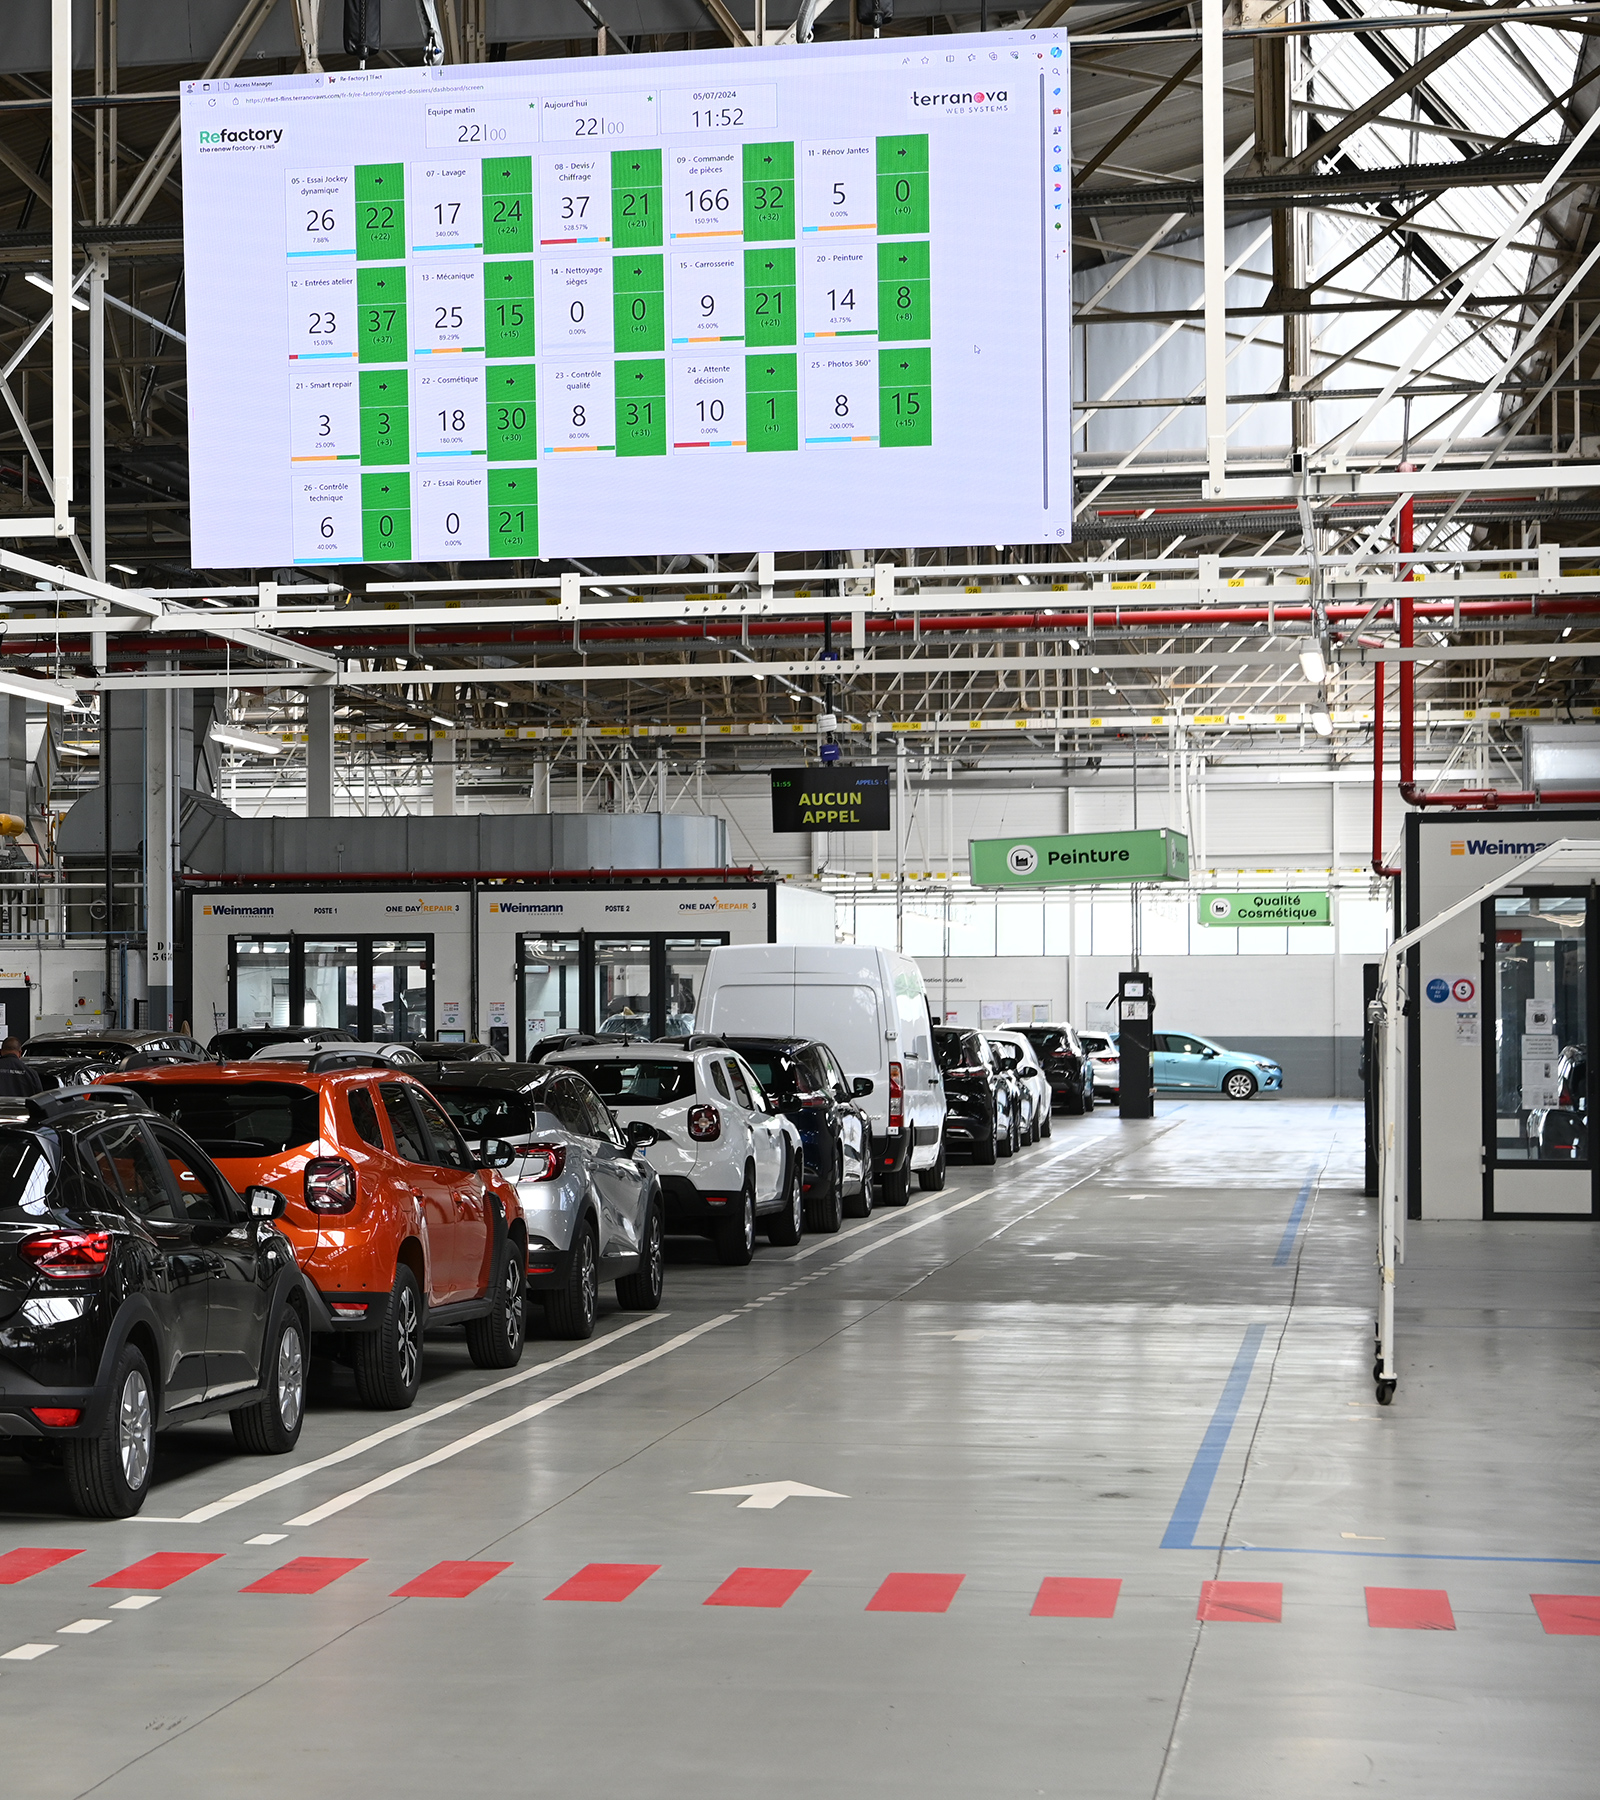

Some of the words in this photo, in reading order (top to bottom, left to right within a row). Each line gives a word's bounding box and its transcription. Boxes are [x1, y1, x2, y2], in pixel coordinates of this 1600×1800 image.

[544, 99, 588, 110] Aujourd'hui
[692, 90, 737, 101] 05/07/2024
[913, 90, 1008, 108] terranova
[427, 108, 453, 118] Equipe
[454, 106, 476, 115] matin
[692, 107, 745, 129] 11:52
[968, 104, 1009, 114] SYSTEMS
[199, 127, 284, 144] Refactory
[676, 156, 686, 164] 09
[692, 153, 735, 163] Commande
[822, 148, 845, 156] Rénov
[846, 147, 870, 155] Jantes
[426, 170, 436, 178] 07
[441, 168, 466, 179] Lavage
[554, 163, 564, 171] 08
[570, 162, 589, 170] Devis
[689, 166, 699, 175] de
[700, 165, 723, 177] pièces
[306, 176, 324, 184] Essai
[324, 175, 348, 186] Jockey
[558, 172, 592, 182] Chiffrage
[300, 186, 339, 196] dynamique
[754, 186, 784, 210] 32
[832, 182, 846, 205] 5
[895, 179, 911, 203] 0
[560, 196, 590, 220] 37
[622, 193, 649, 217] 21
[684, 188, 730, 213] 166
[306, 208, 336, 232] 26
[366, 206, 395, 229] 22
[434, 202, 462, 225] 17
[492, 200, 523, 223] 24
[680, 261, 688, 269] 15
[694, 259, 735, 269] Carrosserie
[816, 255, 826, 263] 20
[833, 253, 864, 262] Peinture
[422, 274, 430, 282] 13
[436, 271, 475, 282] Mécanique
[550, 268, 559, 276] 14
[566, 266, 603, 277] Nettoyage
[290, 280, 299, 288] 12
[304, 278, 330, 287] Entrées
[331, 278, 354, 286] atelier
[566, 277, 588, 287] sièges
[700, 294, 715, 318] 9
[755, 292, 782, 316] 21
[826, 288, 856, 312] 14
[896, 286, 911, 309] 8
[434, 306, 464, 329] 25
[496, 304, 524, 327] 15
[570, 300, 585, 324] 0
[631, 298, 646, 321] 0
[308, 311, 337, 334] 23
[368, 309, 397, 333] 37
[687, 366, 697, 374] 24
[703, 364, 731, 373] Attente
[811, 361, 821, 369] 25
[828, 359, 854, 368] Photos
[855, 359, 872, 367] 360°
[421, 377, 431, 385] 22
[437, 375, 479, 386] Cosmétique
[570, 369, 602, 378] Contrôle
[694, 376, 724, 386] décision
[296, 382, 304, 390] 21
[310, 380, 329, 389] Smart
[330, 380, 353, 390] repair
[566, 380, 591, 392] qualité
[695, 398, 725, 423] 10
[766, 398, 776, 420] 1
[834, 394, 849, 418] 8
[890, 392, 921, 416] 15
[438, 409, 466, 432] 18
[497, 408, 527, 431] 30
[572, 404, 586, 427] 8
[625, 402, 653, 426] 31
[318, 414, 332, 437] 3
[378, 412, 391, 435] 3
[304, 484, 313, 492] 26
[318, 482, 349, 491] Contrôle
[438, 478, 455, 487] Essai
[455, 478, 482, 486] Routier
[309, 493, 344, 503] technique
[320, 516, 334, 539] 6
[379, 514, 394, 538] 0
[446, 512, 460, 535] 0
[499, 510, 525, 534] 21
[798, 792, 862, 806] AUCUN
[802, 810, 860, 824] APPEL
[1048, 848, 1130, 866] Peinture
[212, 905, 274, 916] Weinmann
[405, 905, 421, 913] DAY
[455, 904, 460, 912] 3
[500, 902, 564, 913] Weinmann
[605, 905, 624, 913] POSTE
[679, 903, 697, 911] ONE
[752, 902, 757, 910] 3
[1253, 895, 1301, 908] Qualité
[1238, 908, 1317, 920] Cosmétique
[1460, 986, 1467, 996] 5
